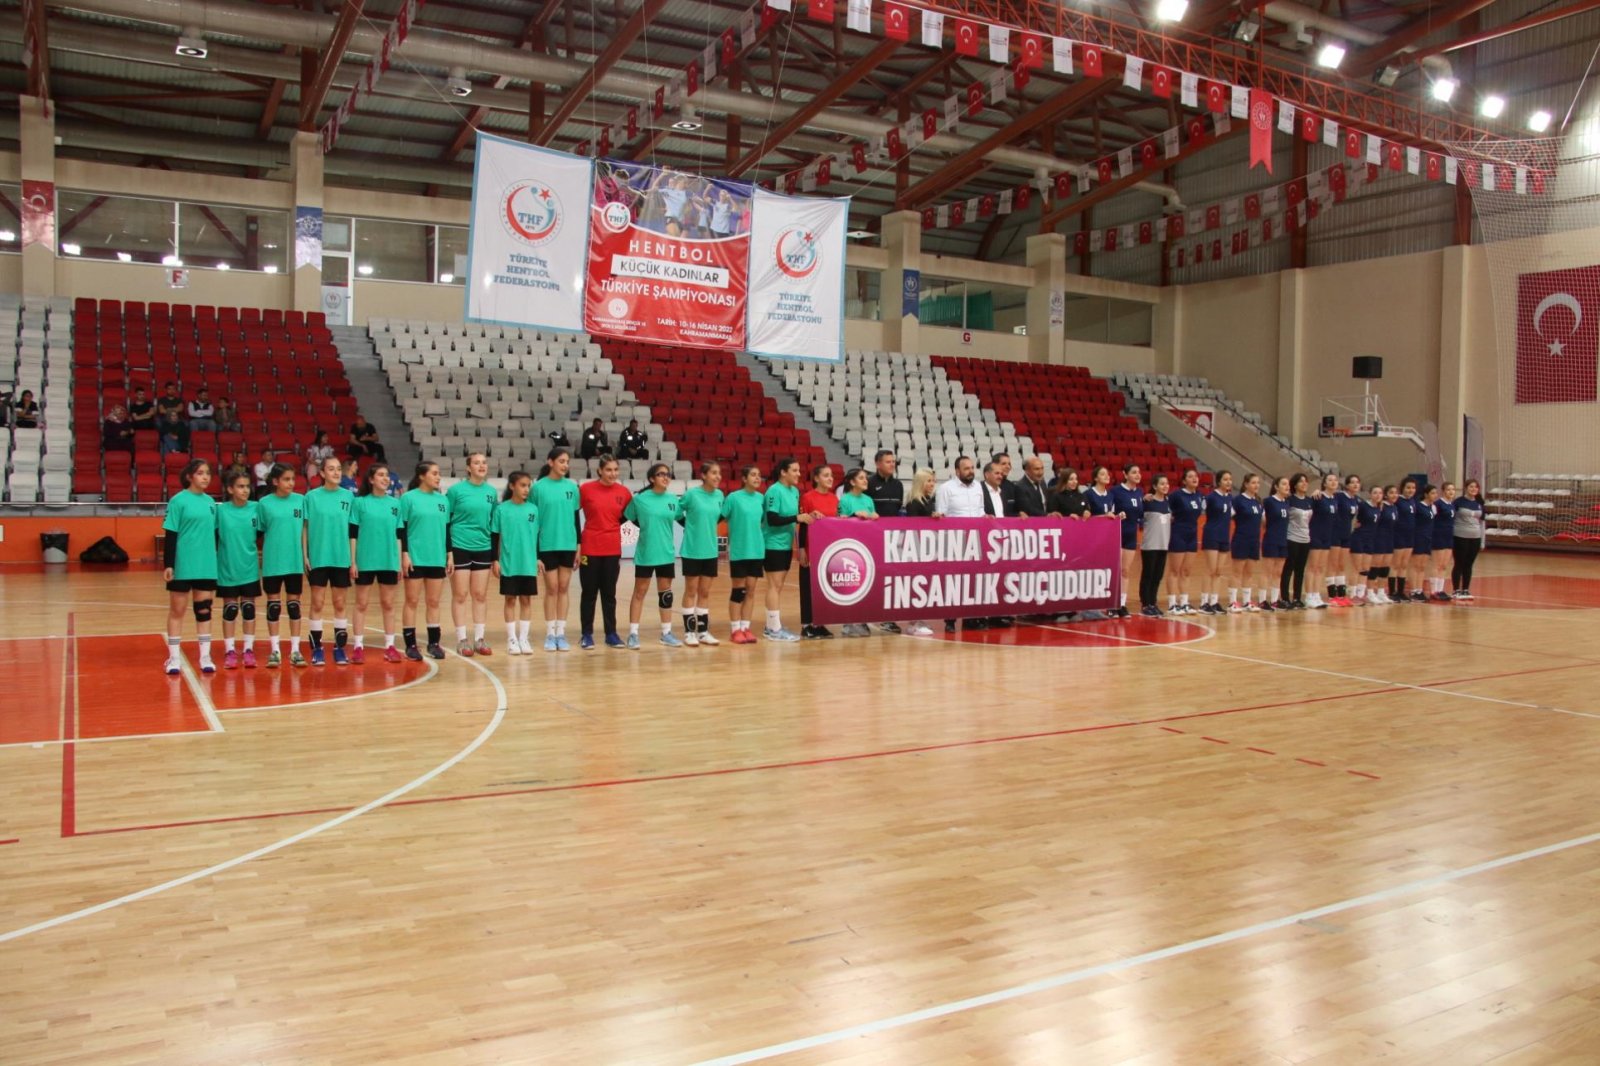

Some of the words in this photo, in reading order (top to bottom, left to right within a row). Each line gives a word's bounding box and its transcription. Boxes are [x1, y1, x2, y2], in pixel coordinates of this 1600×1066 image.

[518, 212, 544, 226] THF
[629, 239, 714, 263] HENTBOL
[172, 270, 183, 284] F
[620, 259, 661, 277] KÜÇÜK
[663, 266, 720, 283] KADINLAR
[600, 278, 650, 295] TÜRKİYE
[652, 285, 737, 308] ŞAMPİYONASI
[962, 332, 971, 343] G
[340, 501, 349, 512] 77
[883, 529, 982, 563] KADINA
[986, 528, 1067, 565] ŞİDDET,
[831, 572, 861, 583] KADES
[883, 572, 1001, 610] İNSANLIK
[1003, 567, 1112, 606] SUÇUDUR!
